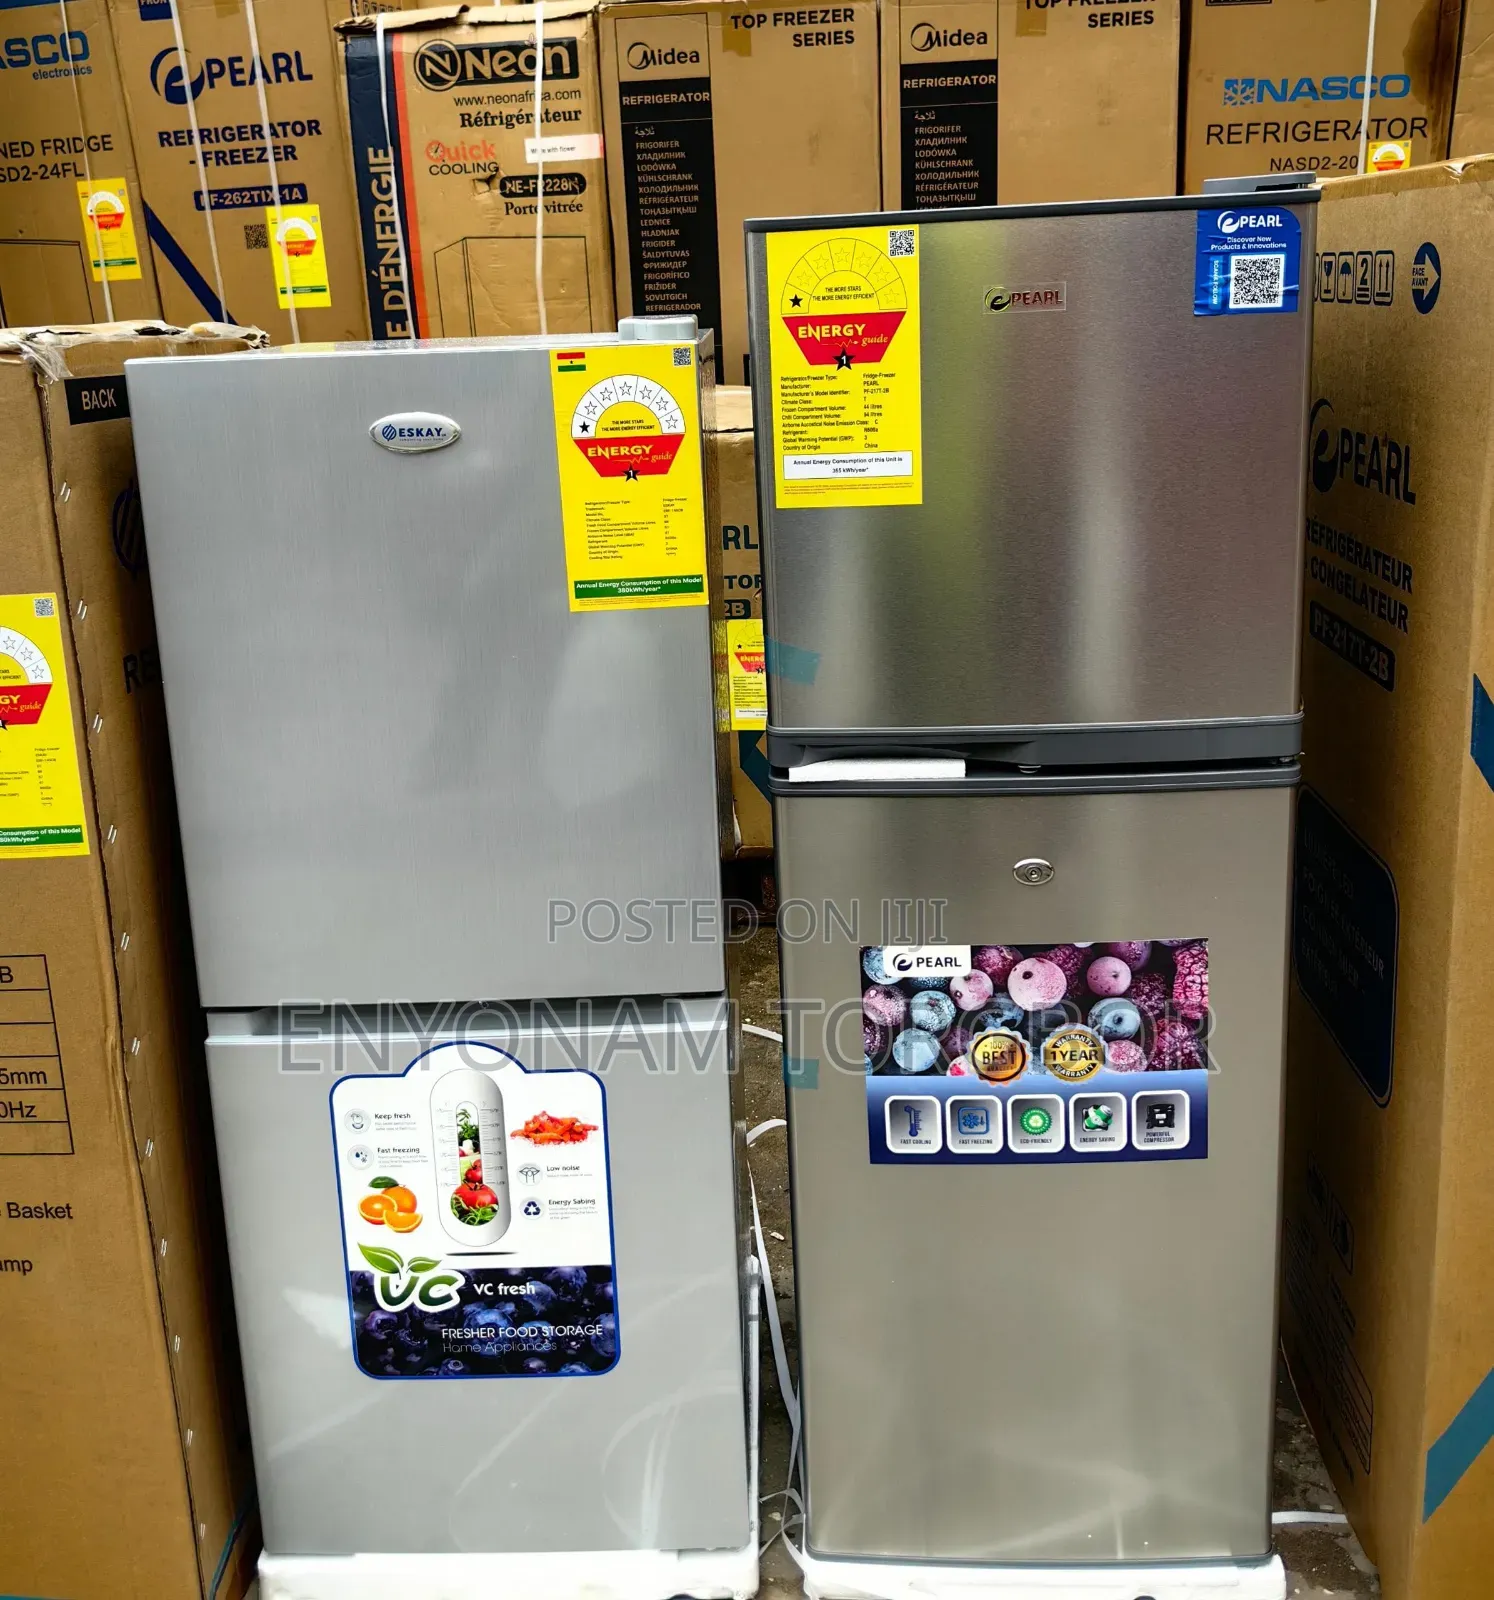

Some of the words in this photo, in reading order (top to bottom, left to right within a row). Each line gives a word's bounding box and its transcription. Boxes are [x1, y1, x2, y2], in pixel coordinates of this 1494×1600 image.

[731, 13, 768, 29] TOP
[773, 8, 855, 26] FREEZER
[1088, 10, 1154, 28] SERIES
[793, 30, 855, 47] SERIES
[912, 24, 988, 51] Midea
[0, 30, 90, 70] SCO
[629, 43, 700, 69] Midea
[465, 44, 571, 81] Neon
[33, 64, 92, 81] electronics
[205, 51, 313, 89] PEARL
[903, 75, 996, 89] REFRIGERATOR
[1257, 74, 1411, 103] NASCO
[622, 92, 710, 106] REFRIGERATOR
[158, 119, 322, 147] REFRIGERATOR
[915, 125, 962, 135] FRIGORIFER
[1206, 117, 1428, 145] REFRIGERATOR
[41, 134, 113, 157] FRIDGE
[425, 140, 497, 163] Quick
[636, 140, 679, 150] FRIGORIFER
[429, 161, 498, 176] COOLING
[915, 158, 974, 169] KÜHLSCHRANK
[638, 174, 693, 182] KÜHLSCHRANK
[915, 170, 980, 181] ХОЛОДИЛЬНИК
[915, 181, 979, 192] RÉFRIGÉRATEUR
[543, 200, 583, 214] vitrée
[641, 218, 671, 226] LEDNICE
[1239, 214, 1282, 228] PEARL
[642, 240, 676, 248] FRIGIDER
[1248, 241, 1287, 249] Innovations
[1412, 267, 1425, 276] FACE
[1412, 278, 1428, 287] AVANT
[835, 293, 852, 301] ENERGY
[1011, 289, 1063, 306] PEARL
[646, 303, 701, 312] REFRIGERADOR
[798, 322, 866, 343] ENERGY
[861, 334, 889, 347] guide
[81, 388, 117, 411] BACK
[399, 427, 443, 438] ESKAY
[587, 444, 653, 459] ENERGY
[651, 451, 673, 462] guide
[1340, 427, 1416, 505] PEARL
[621, 580, 661, 588] Consumption
[19, 701, 42, 712] guide
[916, 956, 962, 969] PEARL
[1055, 1034, 1094, 1048] WARRANTY
[982, 1050, 1017, 1066] BEST
[1055, 1063, 1095, 1077] WARRANTY
[374, 1113, 392, 1121] Keep
[392, 1147, 420, 1155] freezing
[548, 1199, 571, 1207] Energy
[8, 1202, 73, 1219] Basket
[473, 1283, 494, 1296] VC
[499, 1282, 536, 1296] fresh
[442, 1326, 495, 1339] FRESHER
[499, 1326, 538, 1338] FOOD
[541, 1324, 603, 1337] STORAGE
[443, 1342, 482, 1353] Home
[485, 1341, 557, 1355] Appliances
